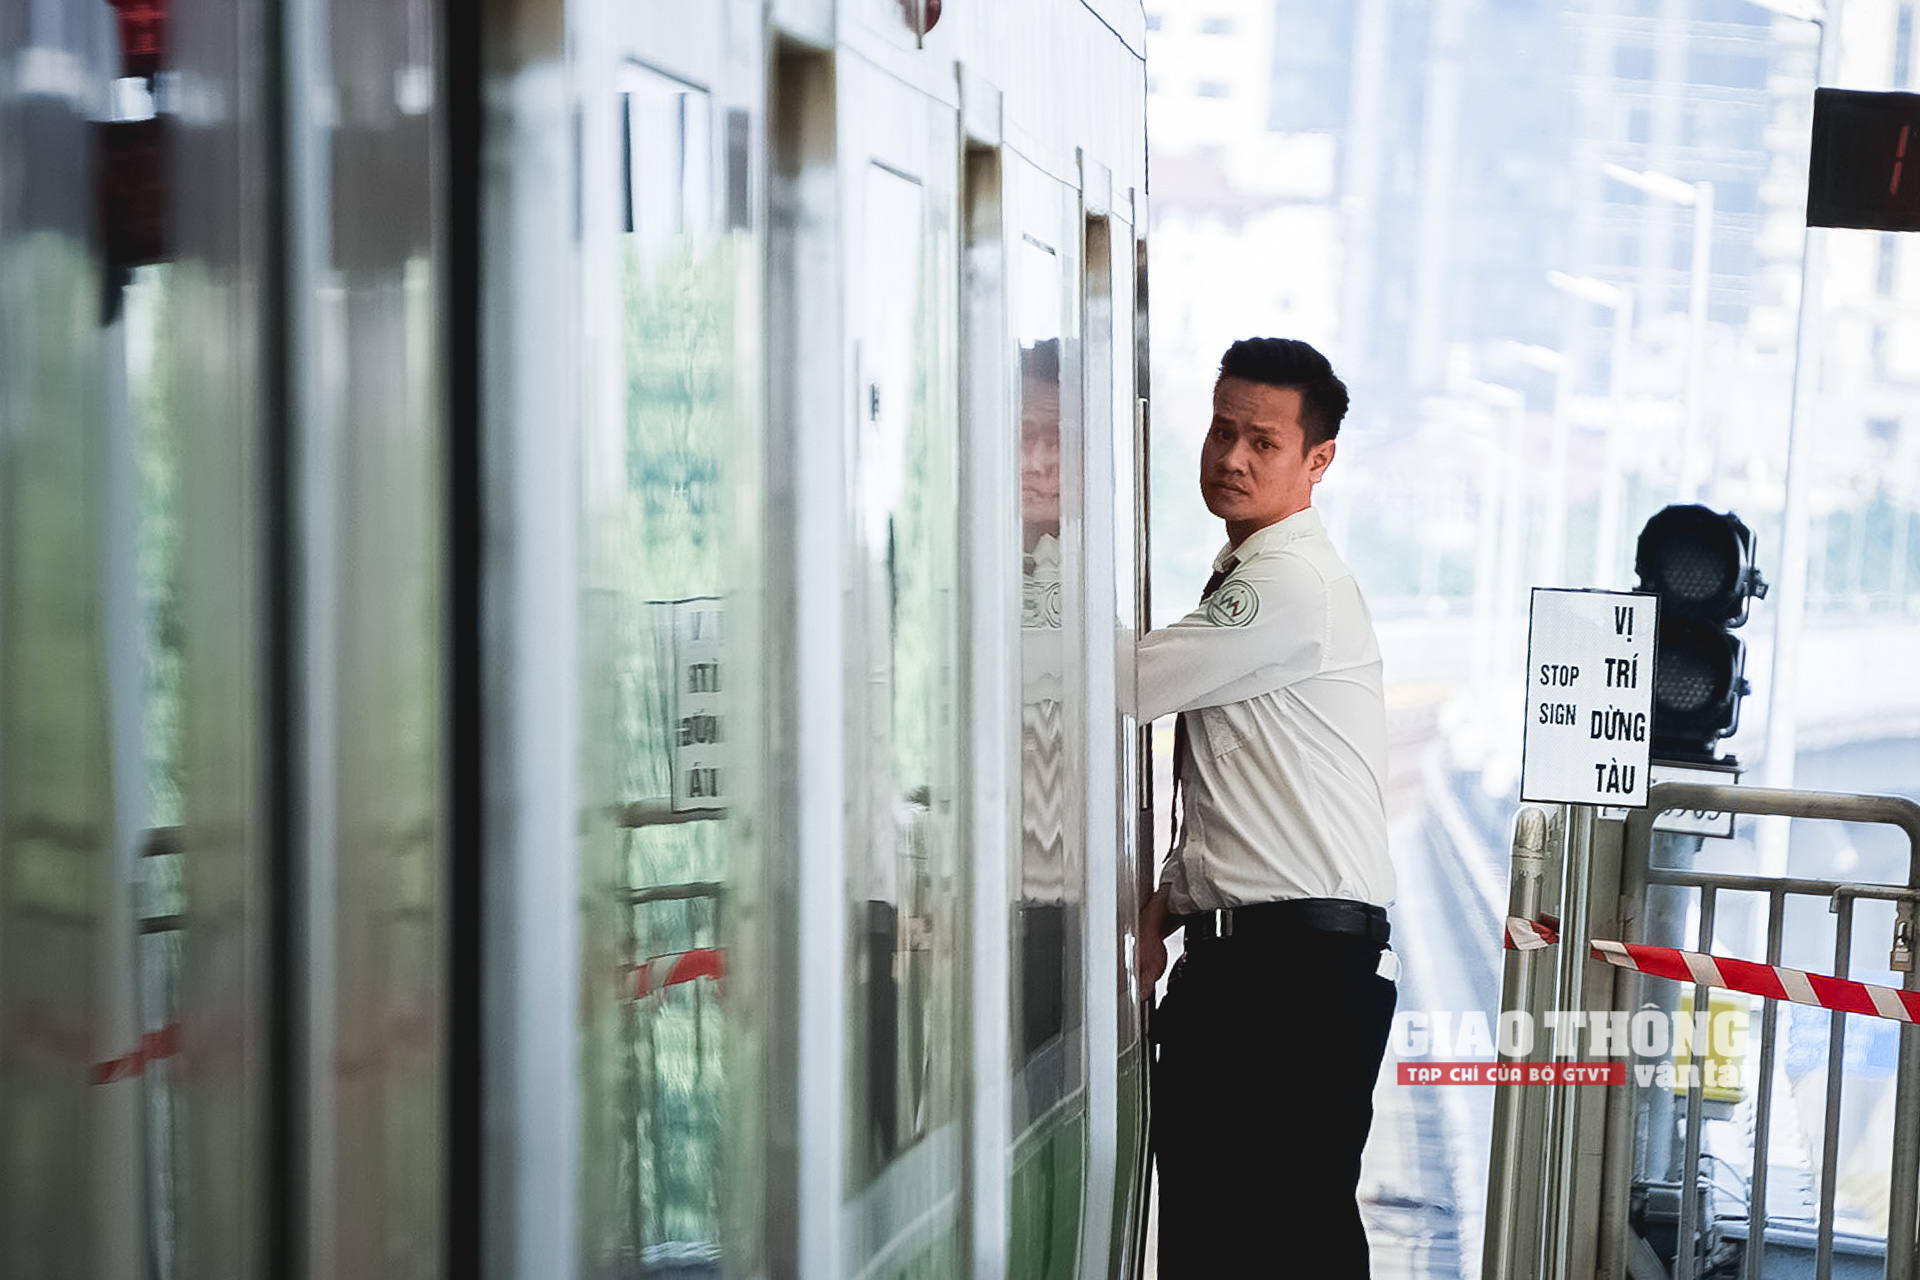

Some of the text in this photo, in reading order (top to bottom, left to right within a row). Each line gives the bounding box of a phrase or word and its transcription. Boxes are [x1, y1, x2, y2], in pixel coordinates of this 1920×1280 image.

[1614, 605, 1634, 642] VỊ
[1539, 664, 1580, 687] STOP
[1604, 652, 1639, 689] TRÍ
[1538, 702, 1577, 726] SIGN
[1590, 704, 1646, 742] DỪNG
[1594, 757, 1636, 794] TÀU
